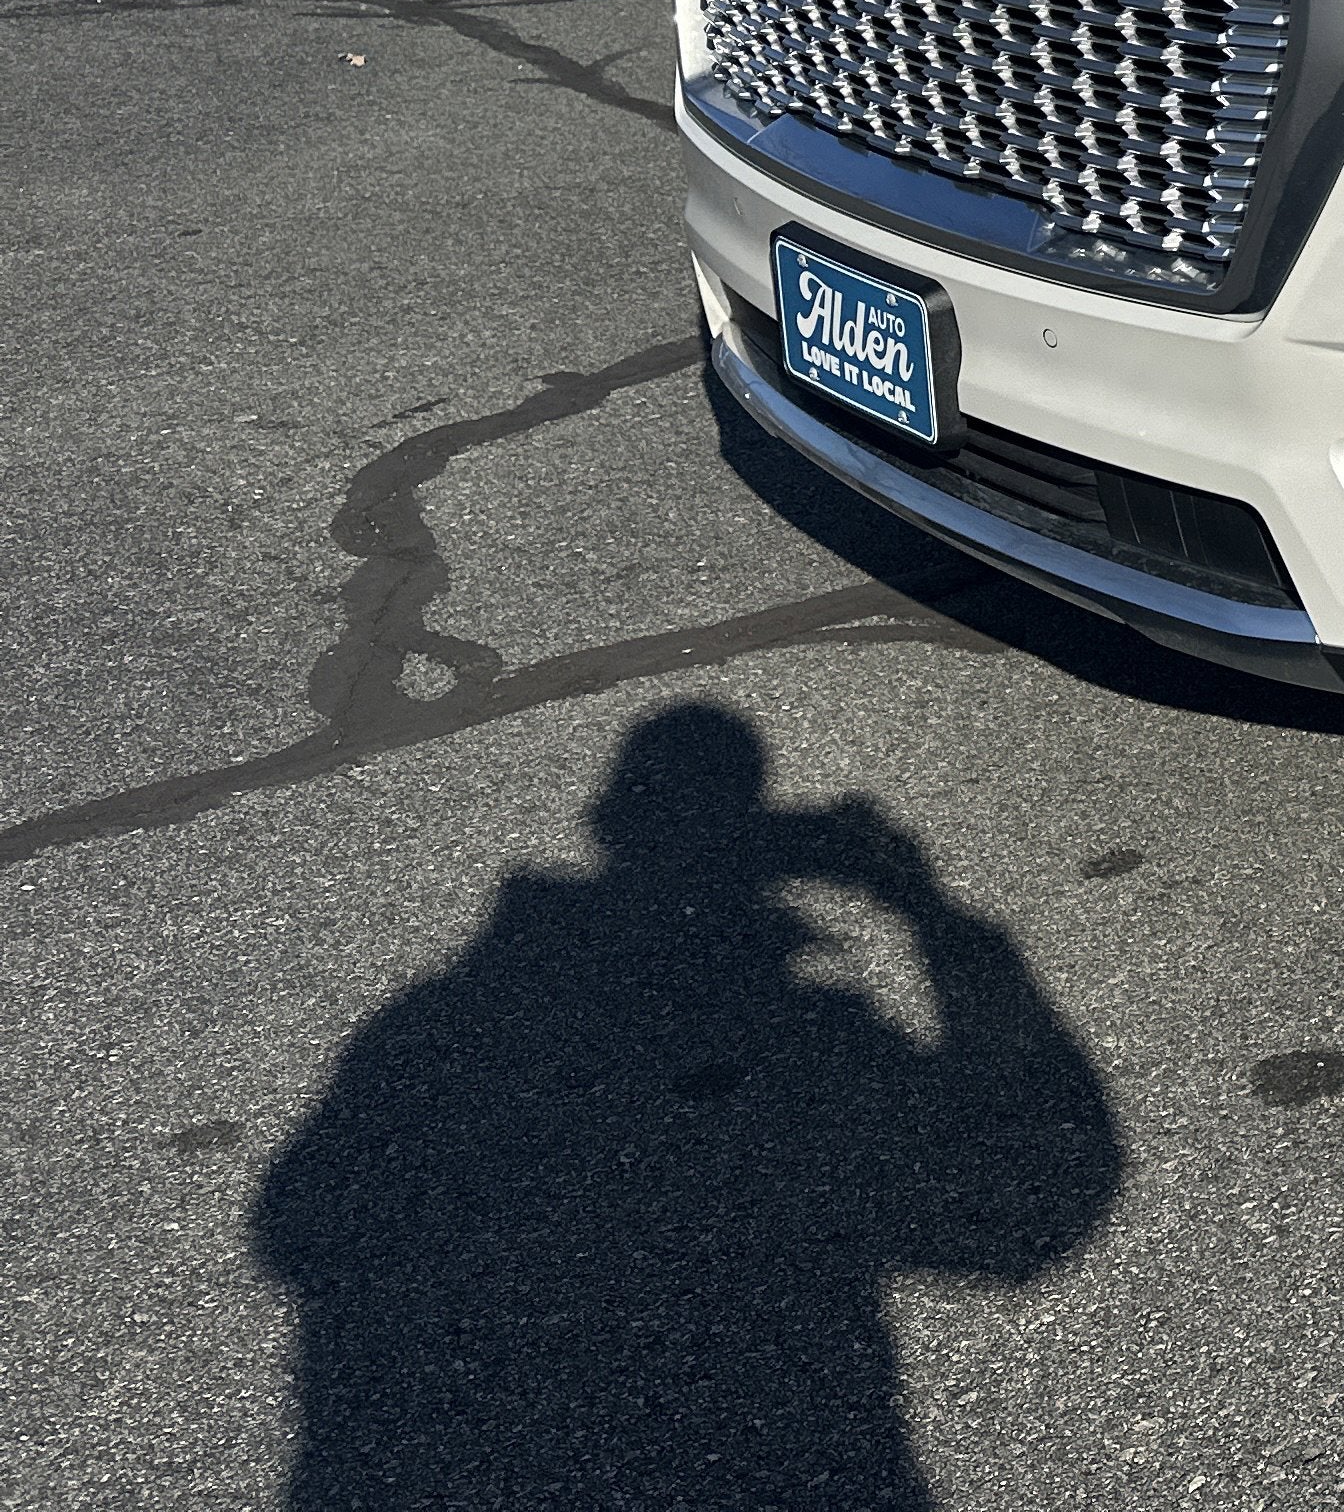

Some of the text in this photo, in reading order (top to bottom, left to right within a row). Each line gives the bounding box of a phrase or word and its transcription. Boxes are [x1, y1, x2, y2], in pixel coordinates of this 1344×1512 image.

[796, 270, 915, 383] Alden
[868, 306, 906, 338] AUTO
[801, 340, 917, 413] LOVE IT LOCAL
